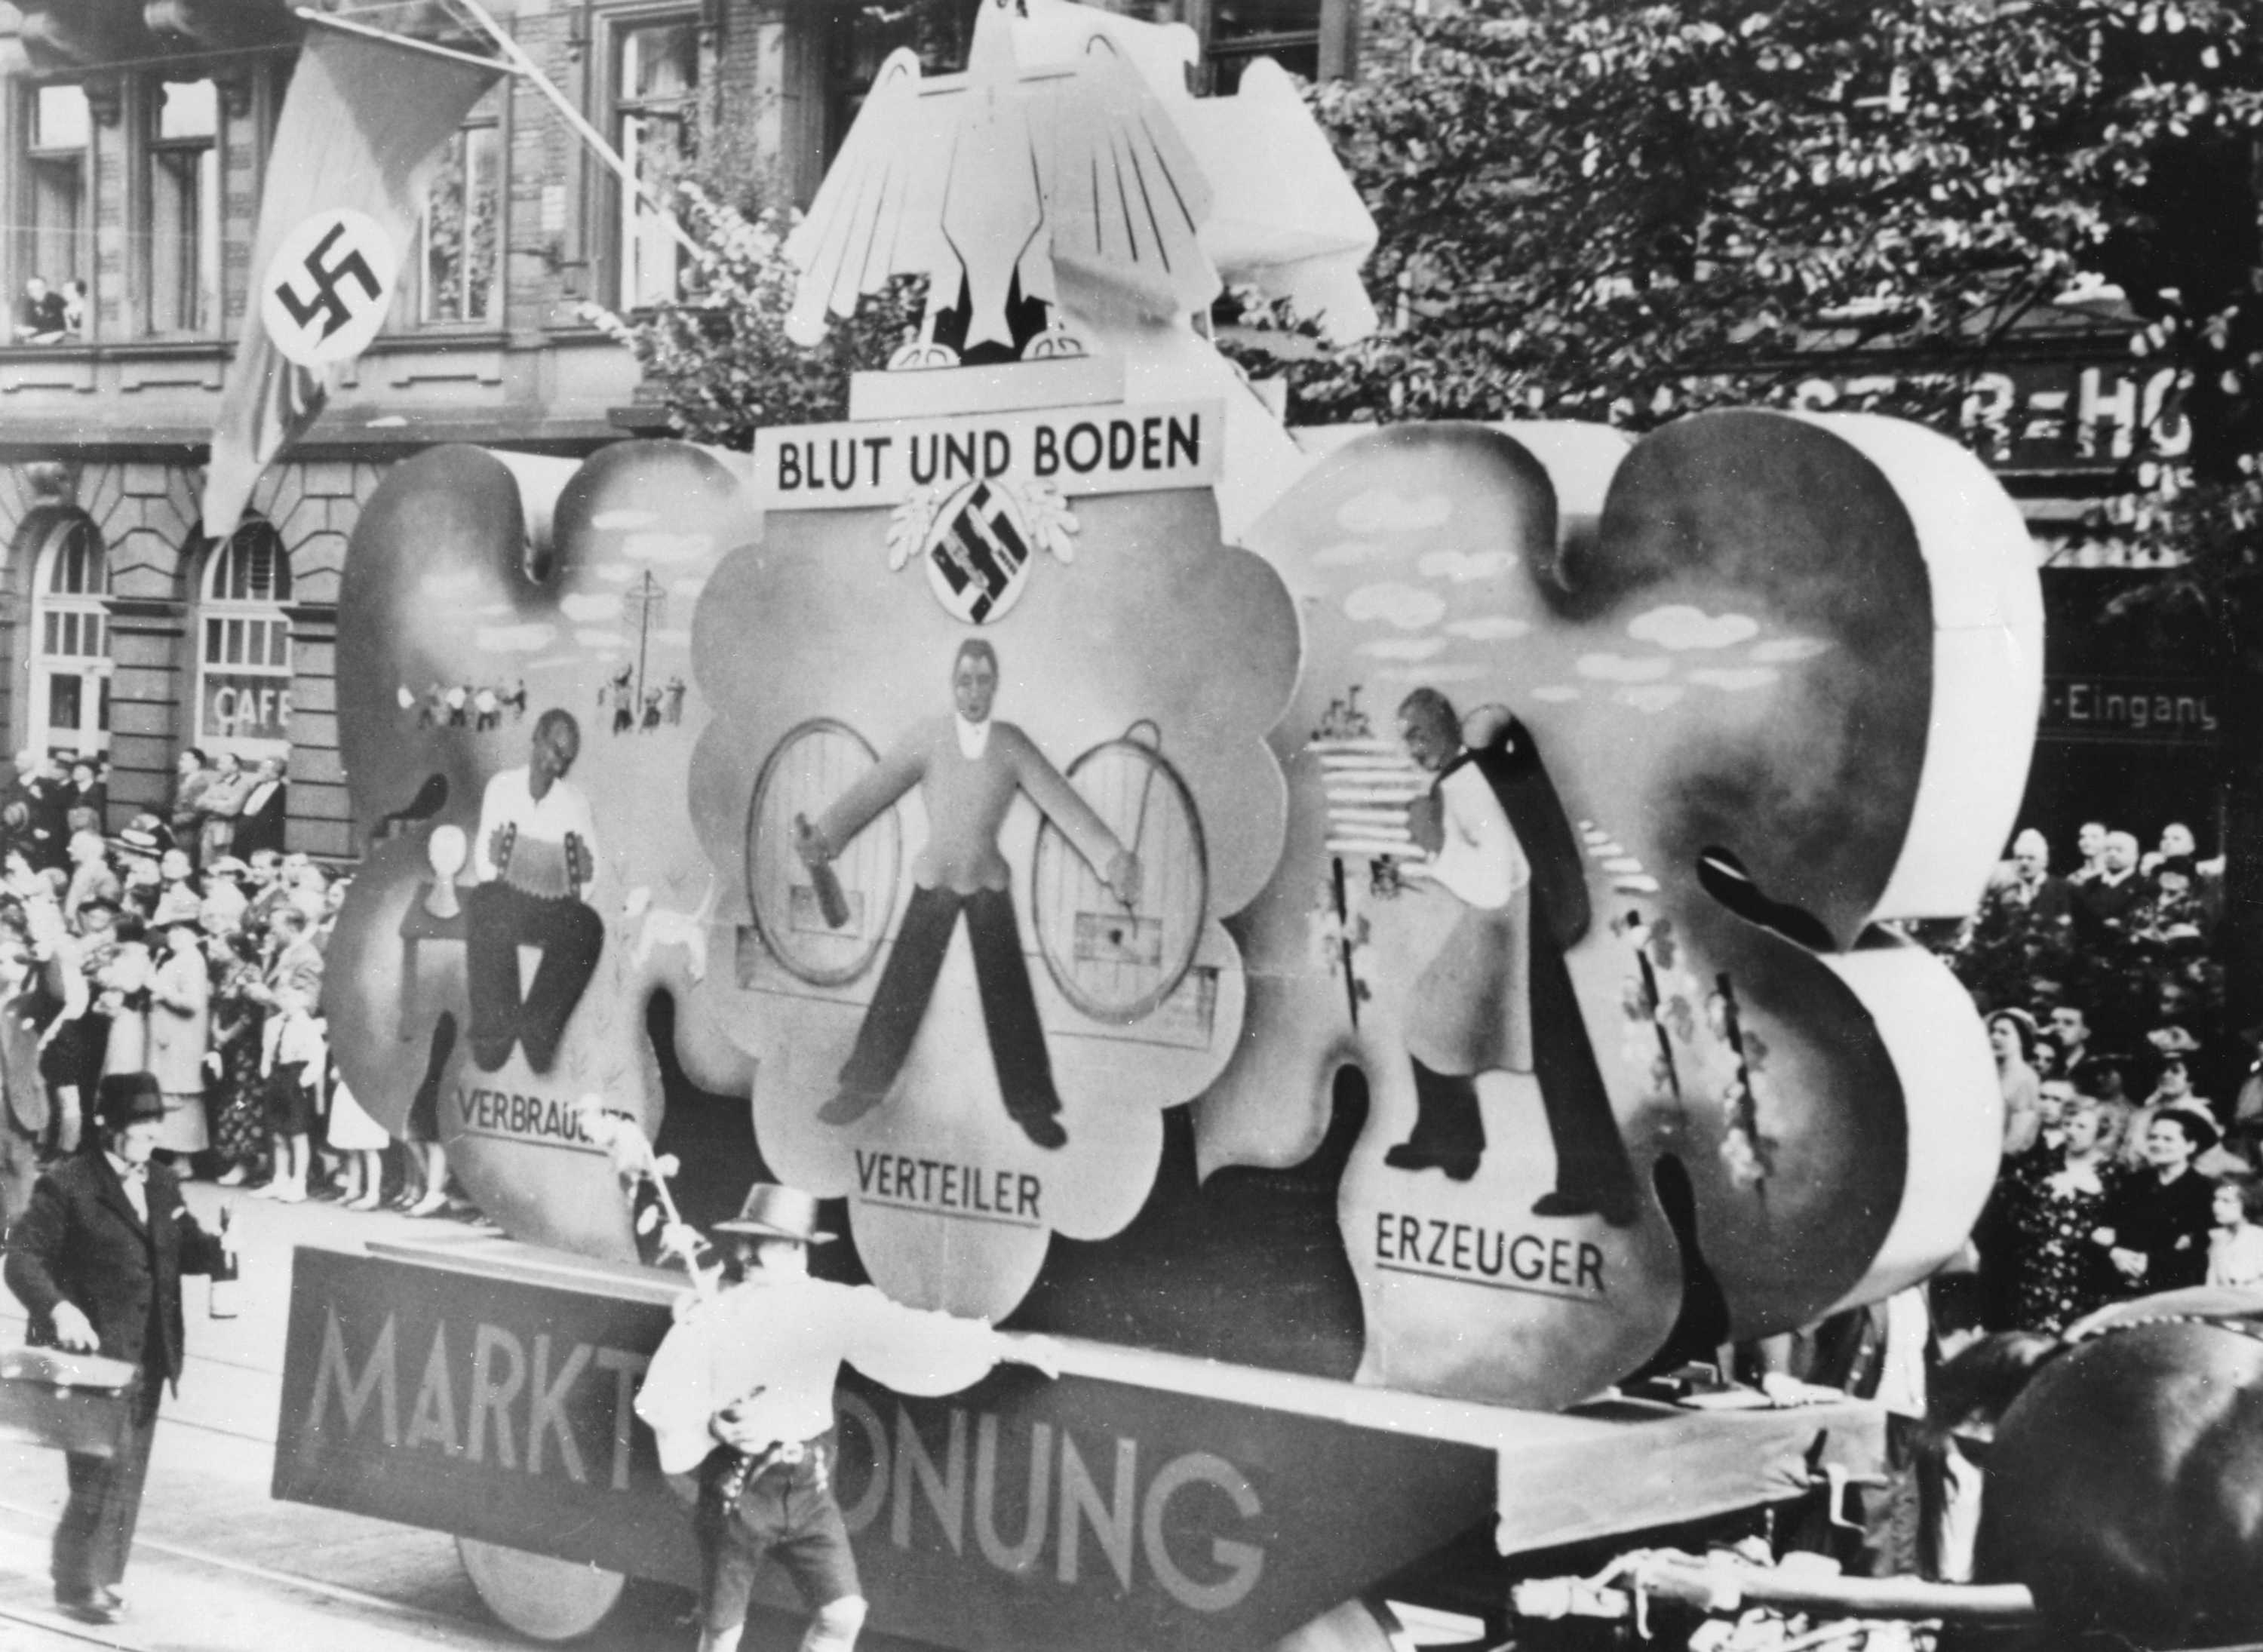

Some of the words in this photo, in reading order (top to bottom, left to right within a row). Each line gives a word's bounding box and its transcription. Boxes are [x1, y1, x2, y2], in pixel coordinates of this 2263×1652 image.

[778, 437, 892, 490] BLUT
[910, 430, 1012, 485] UND
[1034, 413, 1200, 477] BODEN
[458, 1089, 636, 1144] VERBRAU
[855, 1149, 1041, 1218] VERTEILER
[1376, 1211, 1604, 1292] ERZEUGER
[300, 1300, 1265, 1613] MARKTDNUNG
